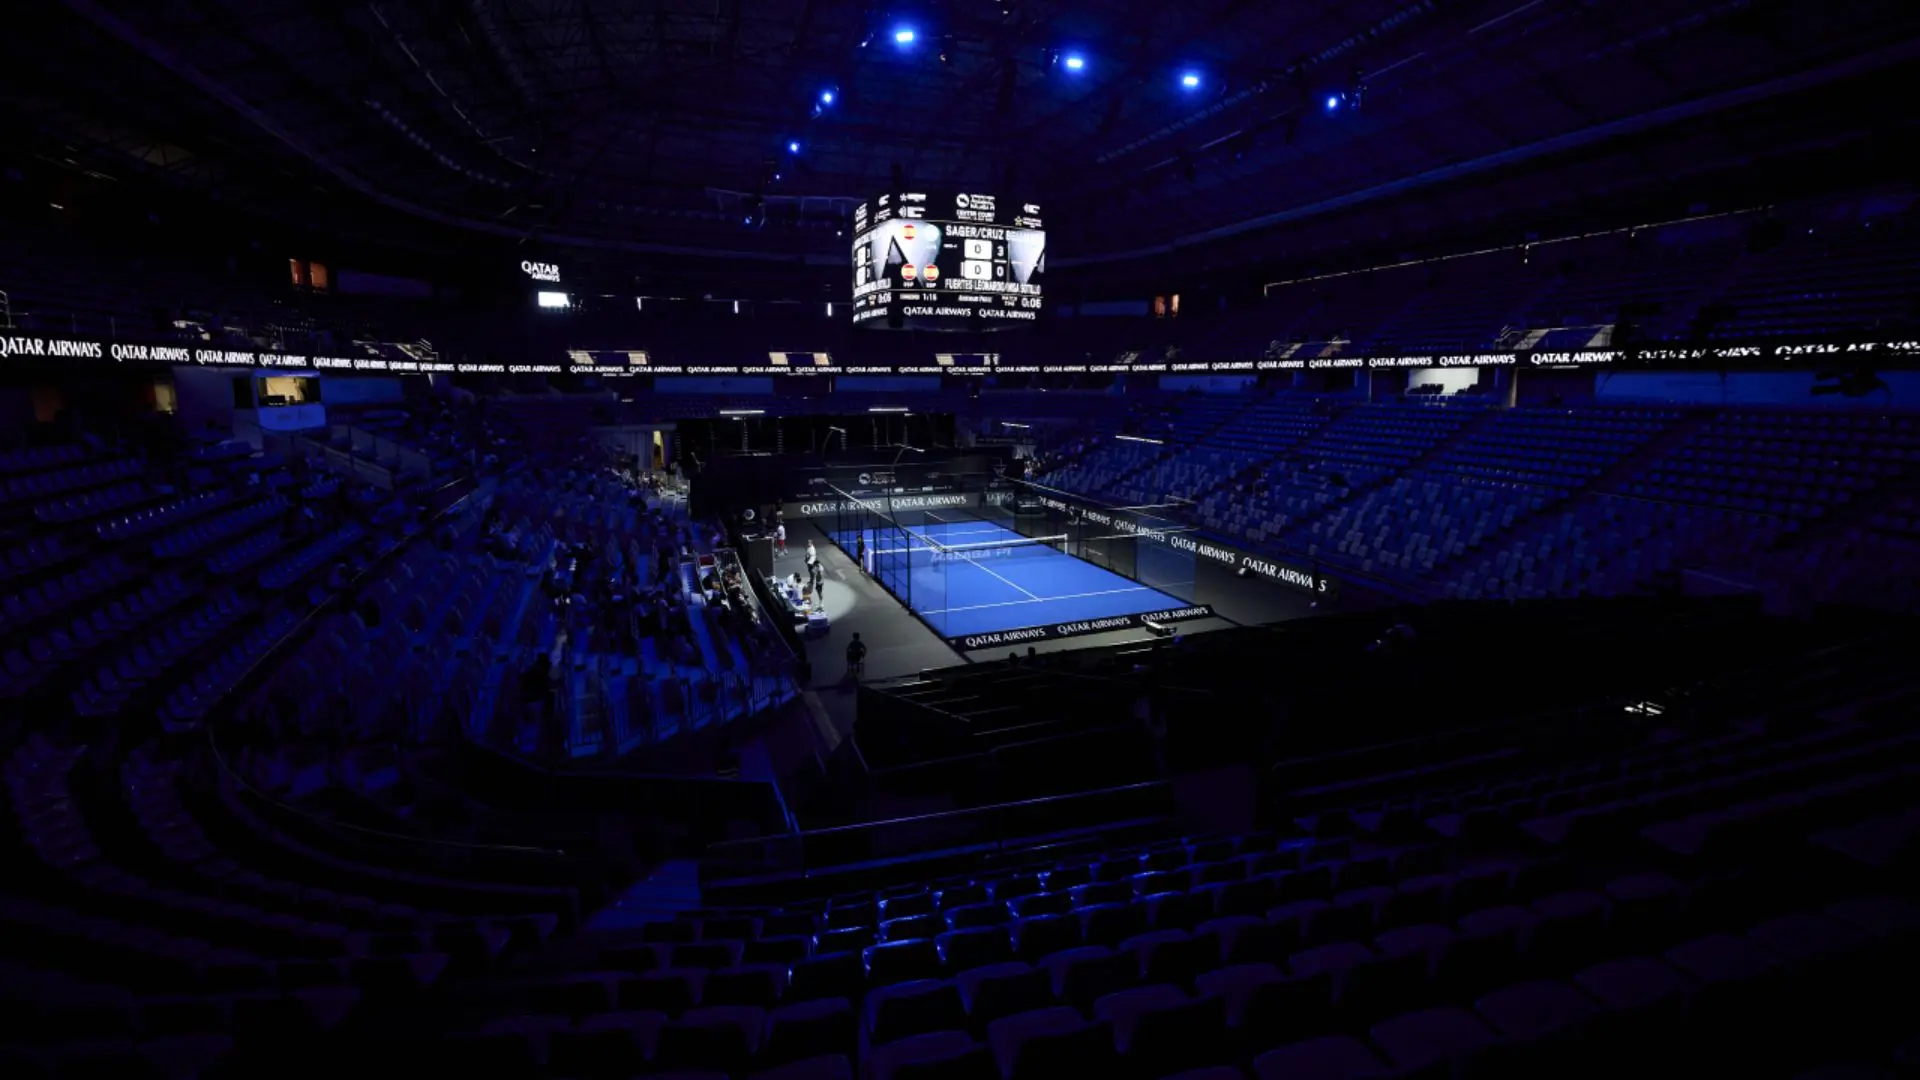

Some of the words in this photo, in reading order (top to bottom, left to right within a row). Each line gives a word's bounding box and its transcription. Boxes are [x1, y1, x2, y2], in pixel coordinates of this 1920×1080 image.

[946, 225, 1004, 241] SAGER/CRUZ
[997, 245, 1004, 257] 3
[521, 260, 560, 276] QATAR
[997, 266, 1004, 277] 0
[903, 306, 934, 317] QATAR
[935, 307, 971, 316] AIRWAYS
[979, 308, 1004, 318] QATAR
[1006, 310, 1036, 320] AIRWAYS
[48, 339, 102, 358] AIRWAYS
[111, 343, 149, 362] QATAR
[150, 346, 189, 362] AIRWAYS
[195, 349, 223, 365] QATAR
[224, 351, 255, 365] AIRWAYS
[1368, 357, 1395, 368] QATAR
[1396, 356, 1432, 367] AIRWAYS
[1439, 356, 1471, 367] QATAR
[1472, 354, 1516, 365] AIRWAYS
[1531, 352, 1570, 365] QATAR
[570, 366, 593, 374] QATAR
[629, 366, 652, 374] QATAR
[1257, 360, 1277, 370] QATAR
[1278, 360, 1304, 369] AIRWAYS
[1309, 359, 1331, 369] QATAR
[1332, 359, 1363, 368] AIRWAYS
[891, 497, 925, 509] QATAR
[927, 495, 967, 505] AIRWAYS
[801, 503, 837, 515] QATAR
[1171, 536, 1196, 552] QATAR
[1197, 544, 1236, 564] AIRWAYS
[1242, 556, 1278, 577] QATAR
[1278, 567, 1327, 592] AIRWAS
[1140, 611, 1172, 626] QATAR
[1172, 606, 1208, 619] AIRWAYS
[1057, 622, 1091, 636] QATAR
[1091, 616, 1131, 630] AIRWAYS
[965, 635, 1003, 648] QATAR
[1003, 627, 1047, 642] AIRWAYS
